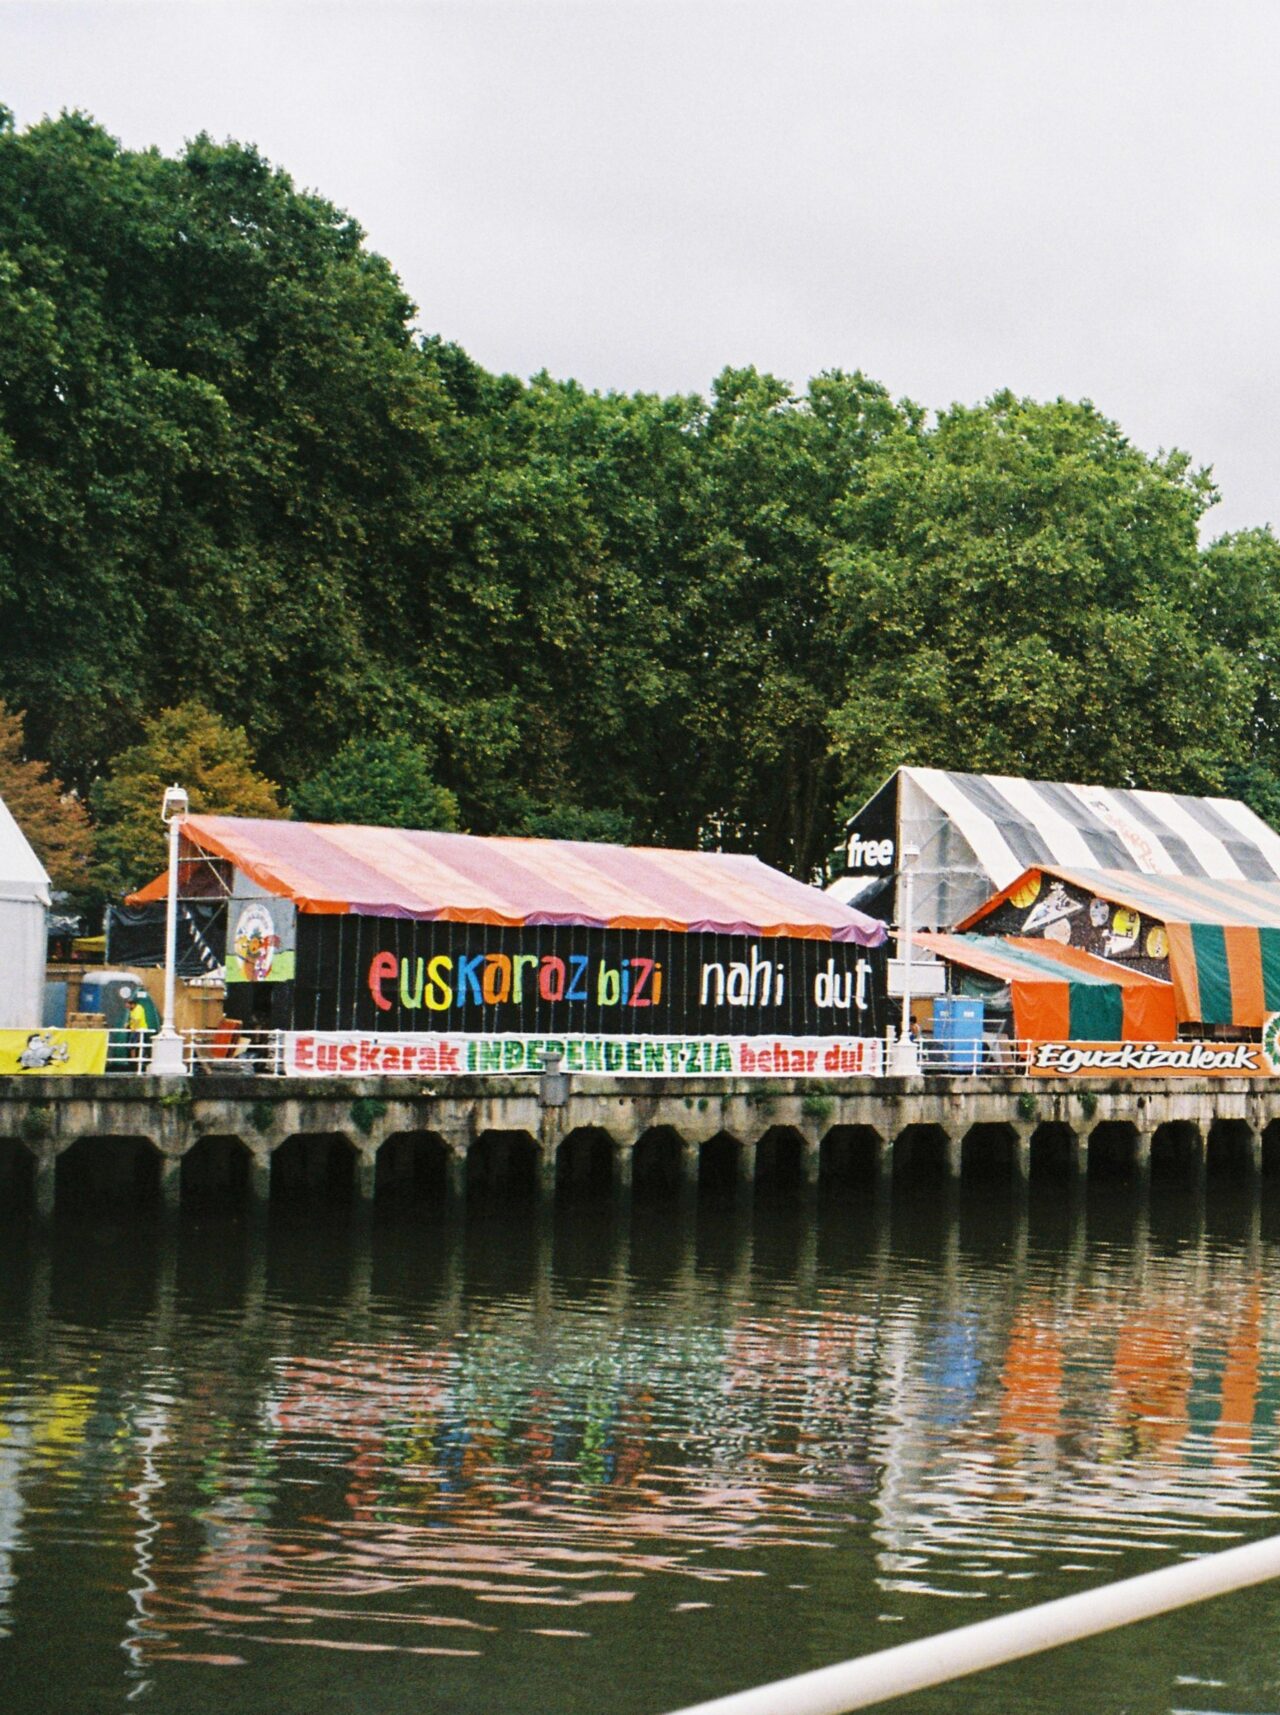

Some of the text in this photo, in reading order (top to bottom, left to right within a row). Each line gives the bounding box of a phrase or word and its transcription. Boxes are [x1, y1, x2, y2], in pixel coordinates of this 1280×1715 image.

[847, 832, 894, 868] free
[368, 951, 589, 1011] euskaraz
[700, 945, 784, 1007] nahi
[815, 958, 872, 1010] dut
[294, 1036, 461, 1072] Euskarak
[740, 1042, 818, 1072] behar
[1035, 1043, 1258, 1073] Eguzkizaleak
